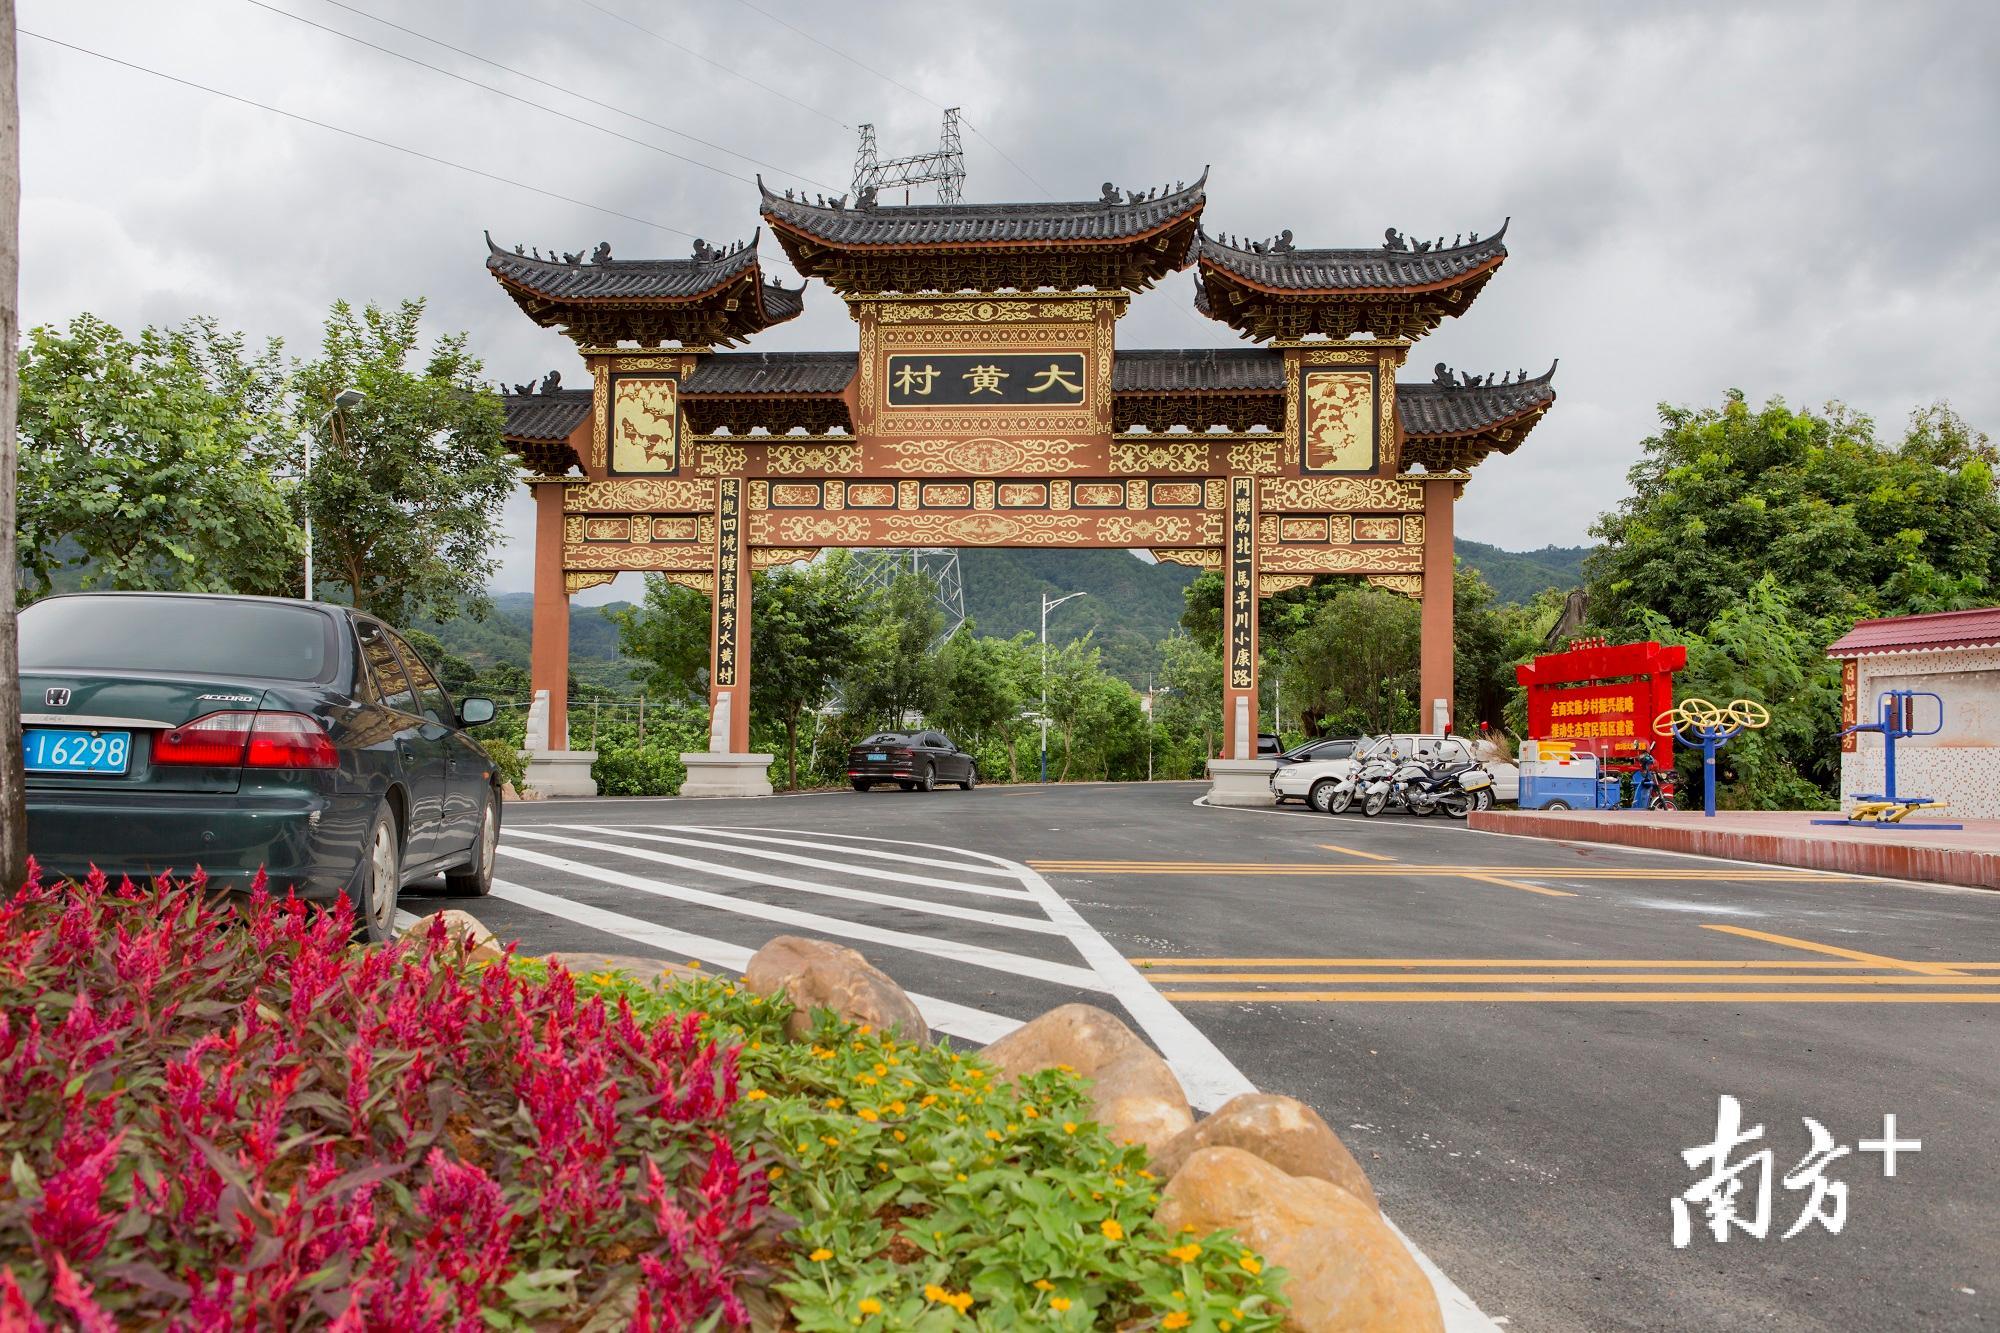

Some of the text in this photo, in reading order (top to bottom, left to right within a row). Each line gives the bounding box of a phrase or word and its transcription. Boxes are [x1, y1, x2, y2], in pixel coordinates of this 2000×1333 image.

[1233, 478, 1252, 687] 門聯南北一馬平川小康路
[195, 693, 253, 703] ACCORD
[1550, 695, 1635, 717] 全面实施乡村振兴战略
[1550, 719, 1635, 739] 推动生态富民强区建设
